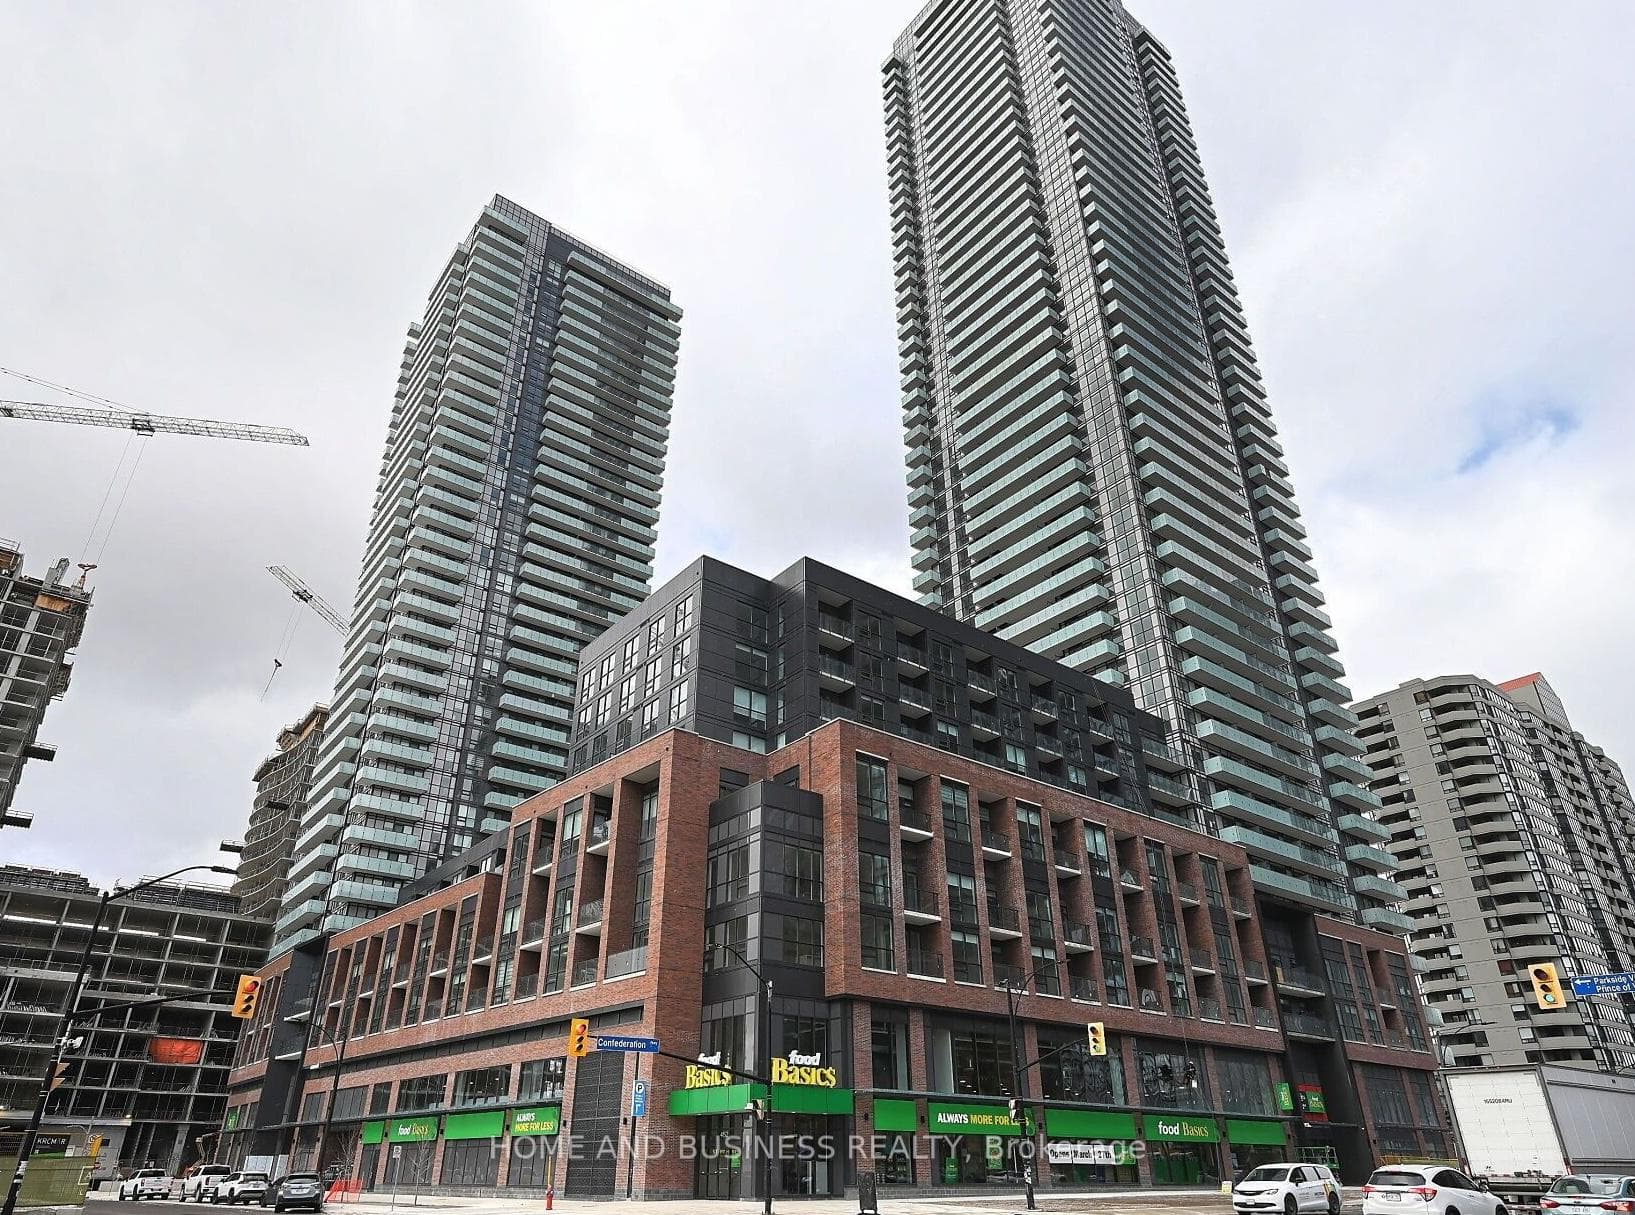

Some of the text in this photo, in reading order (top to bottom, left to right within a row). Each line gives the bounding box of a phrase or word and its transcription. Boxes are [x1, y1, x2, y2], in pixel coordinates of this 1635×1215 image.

[1594, 974, 1627, 984] Parkside
[1596, 985, 1621, 993] Prince
[1623, 982, 1631, 991] of
[598, 1038, 646, 1049] Confederation
[697, 1051, 721, 1067] food
[788, 1050, 821, 1066] food
[541, 1120, 554, 1131] LESS
[937, 1113, 969, 1124] ALWAYS
[970, 1114, 993, 1125] MORE
[994, 1115, 1010, 1126] FOR
[398, 1124, 412, 1137] food
[1158, 1120, 1180, 1136] food
